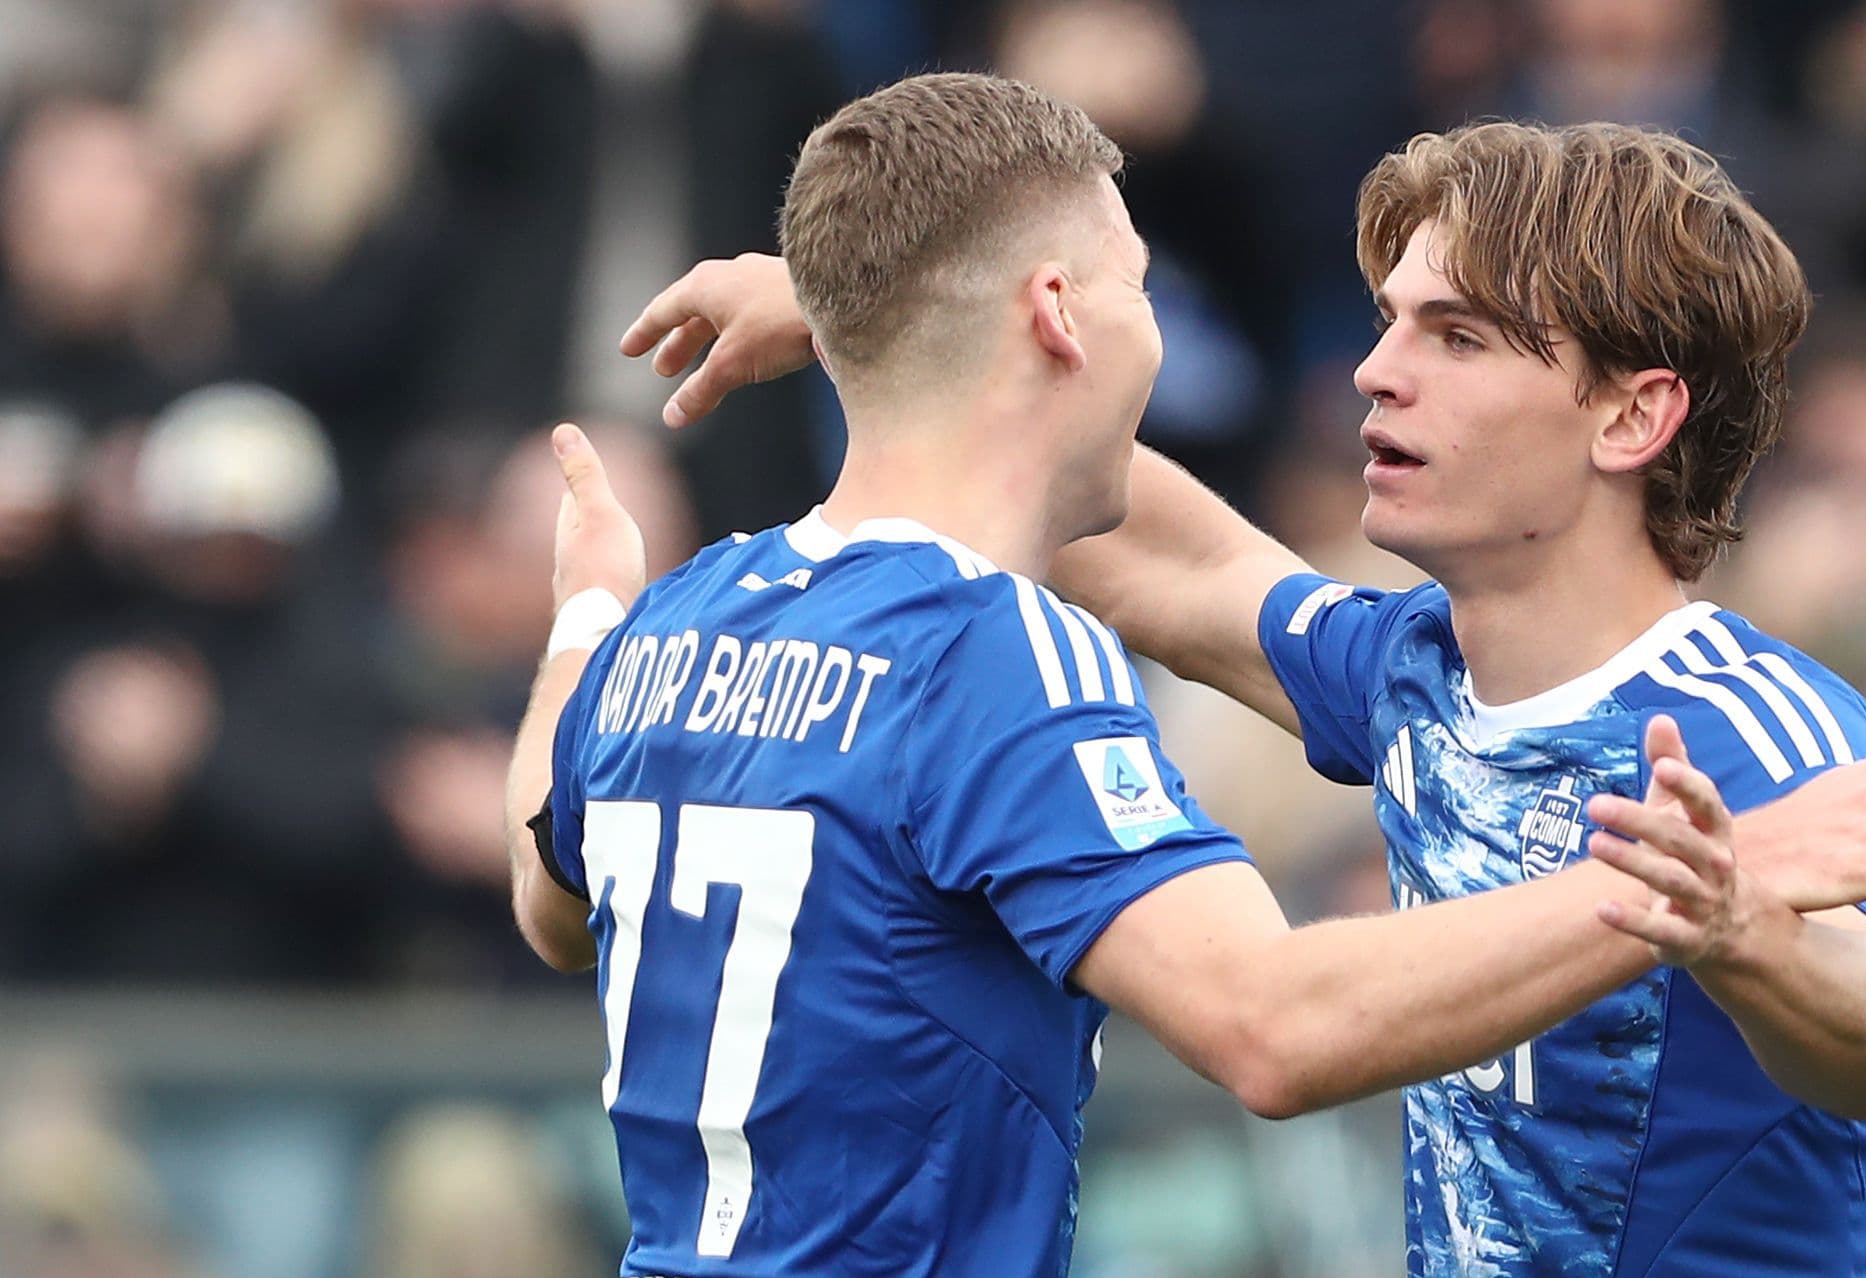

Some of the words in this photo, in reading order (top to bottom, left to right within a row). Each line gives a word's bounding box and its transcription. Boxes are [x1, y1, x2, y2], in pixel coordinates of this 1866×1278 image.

[684, 634, 892, 754] BREMPT
[1530, 810, 1572, 848] COMO
[582, 800, 815, 1258] 77
